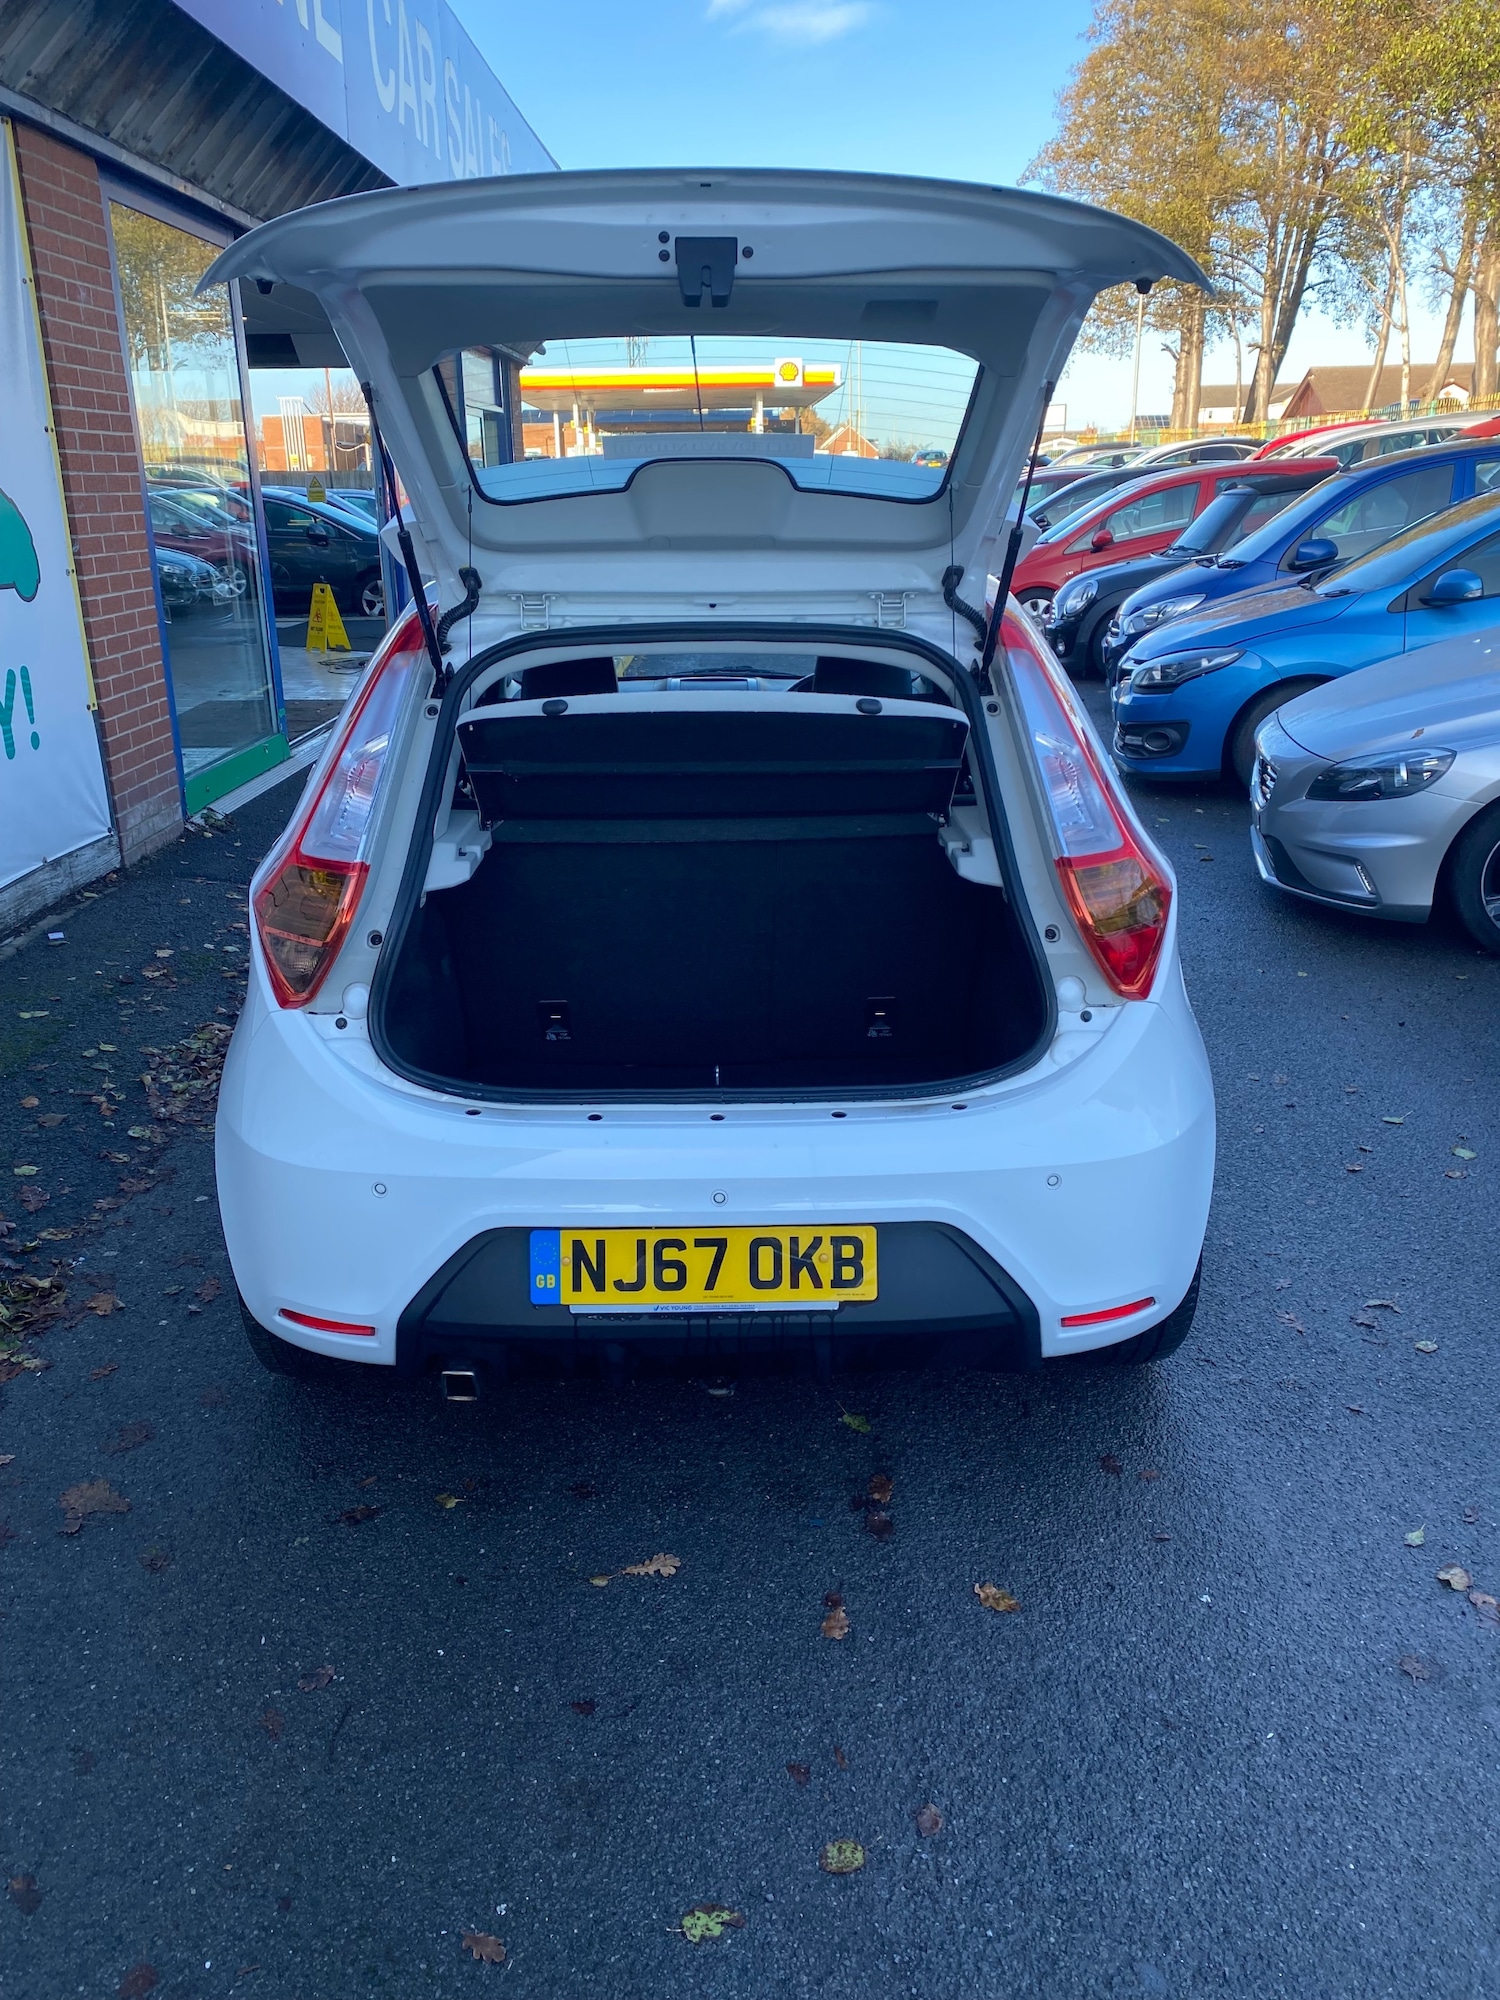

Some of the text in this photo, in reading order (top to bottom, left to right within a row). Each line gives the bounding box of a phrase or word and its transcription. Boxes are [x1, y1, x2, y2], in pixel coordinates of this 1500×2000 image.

[366, 0, 441, 161] CAR
[536, 1274, 556, 1289] GB
[571, 1235, 865, 1292] NJ67 OKB
